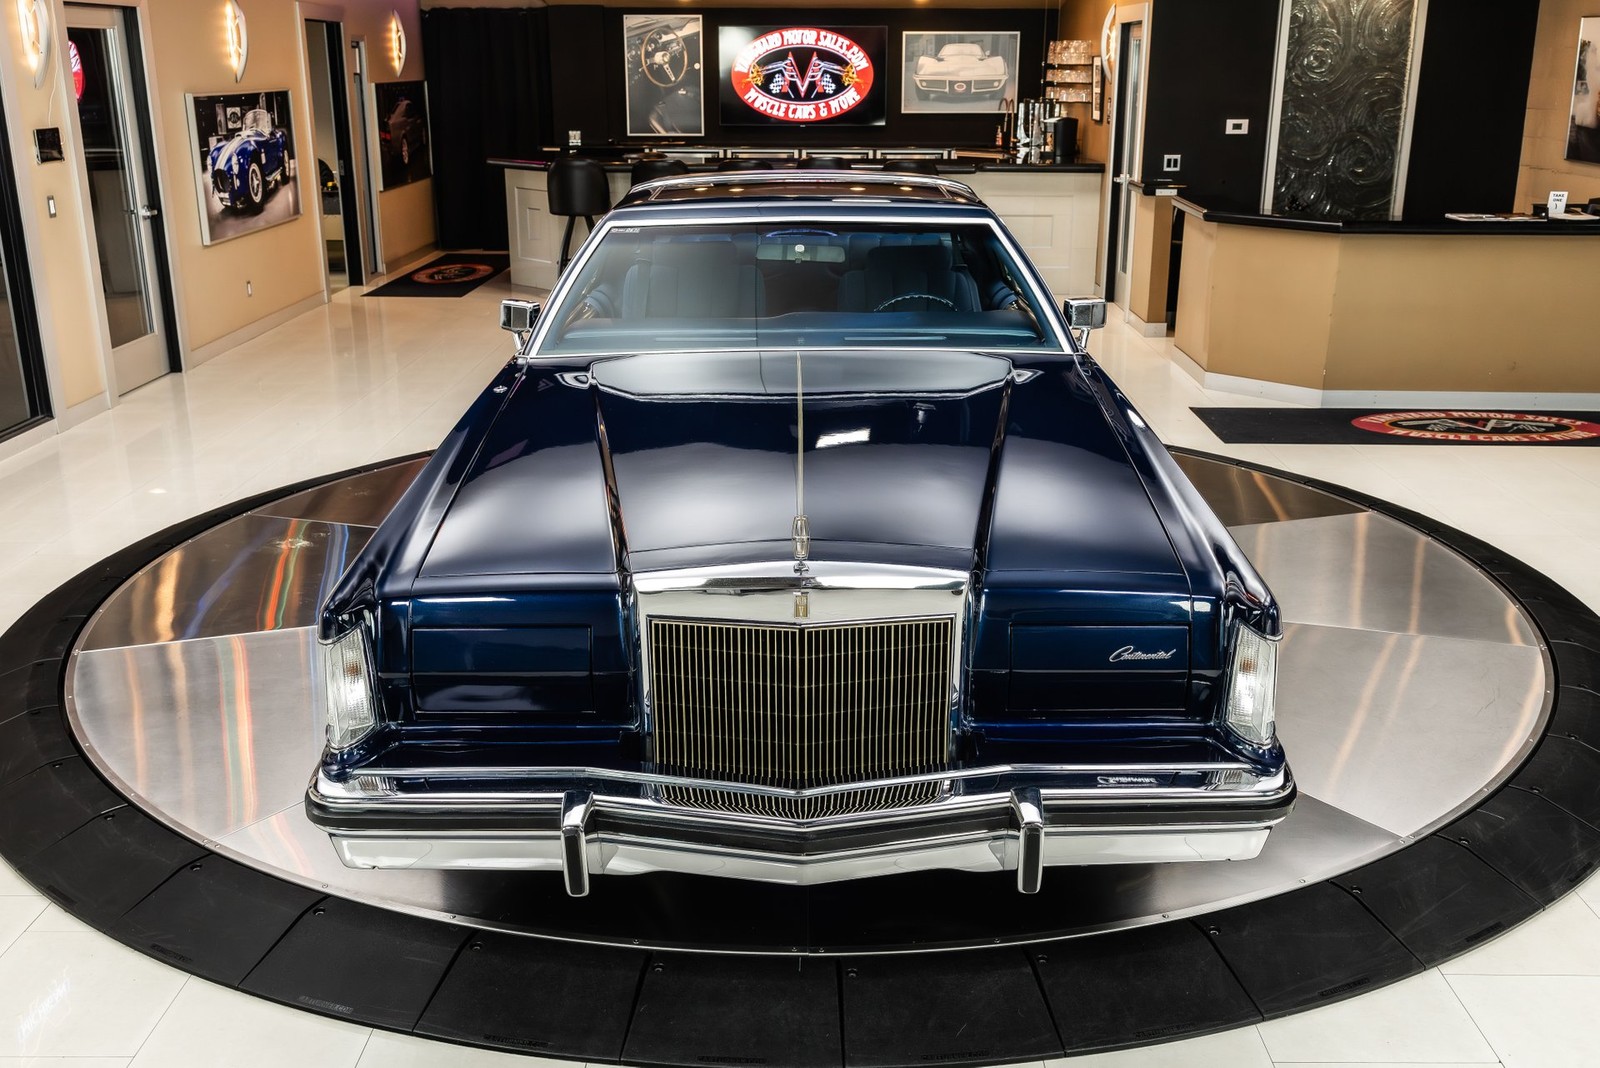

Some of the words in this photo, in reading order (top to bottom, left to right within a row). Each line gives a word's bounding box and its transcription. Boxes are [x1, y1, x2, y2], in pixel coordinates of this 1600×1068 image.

[735, 33, 781, 72] VAGUARD
[783, 29, 817, 45] MOTOR
[818, 31, 869, 70] SALES.COM
[744, 89, 786, 116] MUSCLE
[788, 104, 816, 119] CARS
[819, 102, 828, 117] &
[830, 88, 860, 112] MORE
[1447, 411, 1517, 419] MOTOR
[1387, 429, 1471, 441] MUSCLE
[1108, 645, 1177, 663] Continental
